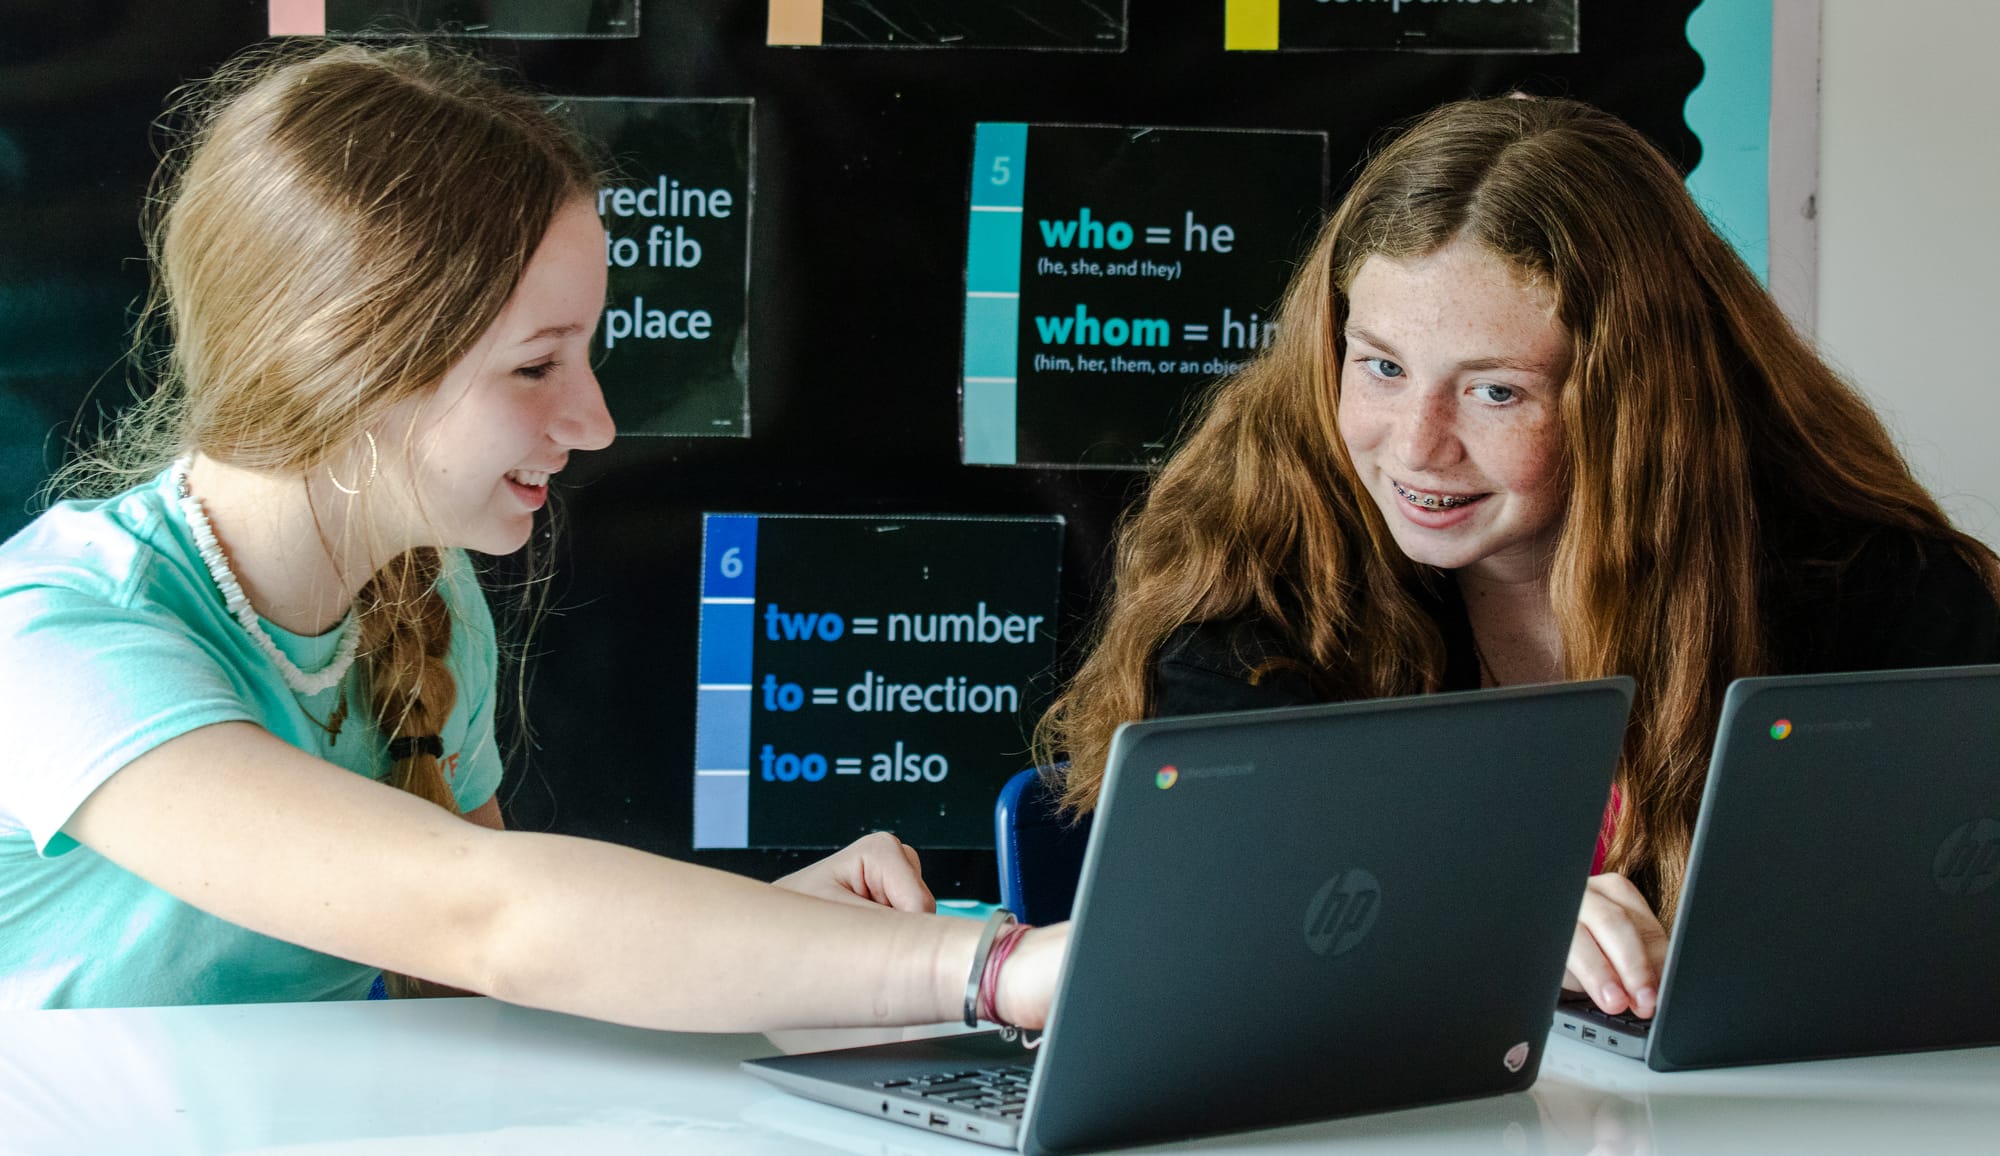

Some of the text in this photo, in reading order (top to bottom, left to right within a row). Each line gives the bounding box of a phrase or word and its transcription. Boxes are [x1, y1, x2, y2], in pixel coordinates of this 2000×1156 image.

[991, 156, 1010, 185] 5
[597, 175, 732, 217] recline
[647, 225, 701, 267] fib
[1040, 208, 1234, 252] who = he
[1038, 258, 1181, 280] (he, she, and they)
[606, 296, 712, 348] place
[1036, 304, 1169, 346] whom
[1184, 325, 1208, 340] =
[1035, 354, 1074, 372] (him,
[1078, 355, 1107, 373] her,
[1111, 356, 1155, 373] them,
[1159, 361, 1176, 372] or
[1180, 362, 1199, 373] an
[721, 548, 742, 577] 6
[765, 602, 1043, 643] two = number
[762, 671, 1017, 712] to = direction
[760, 741, 948, 782] too = also
